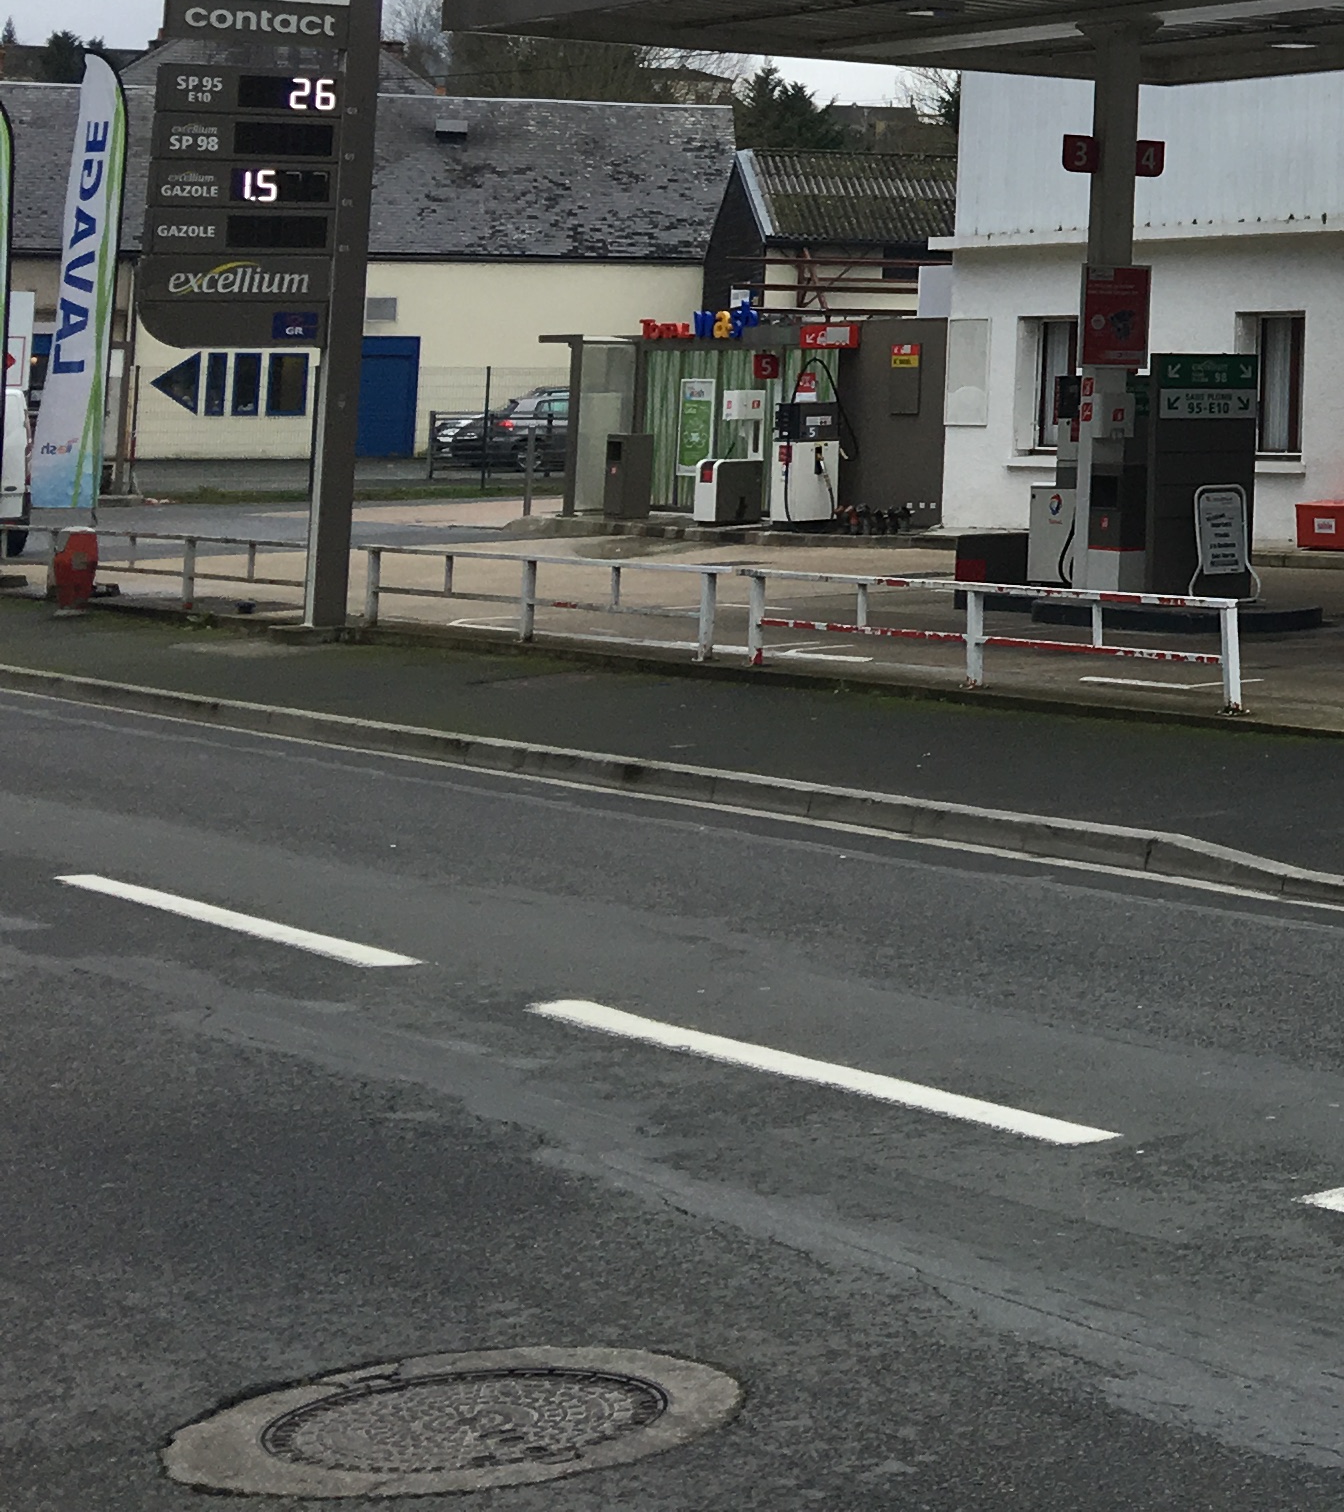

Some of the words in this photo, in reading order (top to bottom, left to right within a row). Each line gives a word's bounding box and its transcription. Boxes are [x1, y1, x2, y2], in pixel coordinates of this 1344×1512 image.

[184, 6, 336, 37] contact
[176, 75, 199, 90] SP
[200, 76, 223, 92] 95
[188, 92, 212, 103] E10
[289, 77, 336, 110] 26
[169, 135, 193, 150] SP
[197, 136, 219, 152] 98
[1074, 141, 1088, 167] 3
[1141, 146, 1156, 170] 4
[161, 184, 219, 198] GAZOLE
[157, 225, 216, 238] GAZOLE
[168, 266, 310, 294] excellium
[761, 358, 772, 375] 5
[1214, 372, 1228, 383] 98
[1188, 402, 1230, 414] 95-E10
